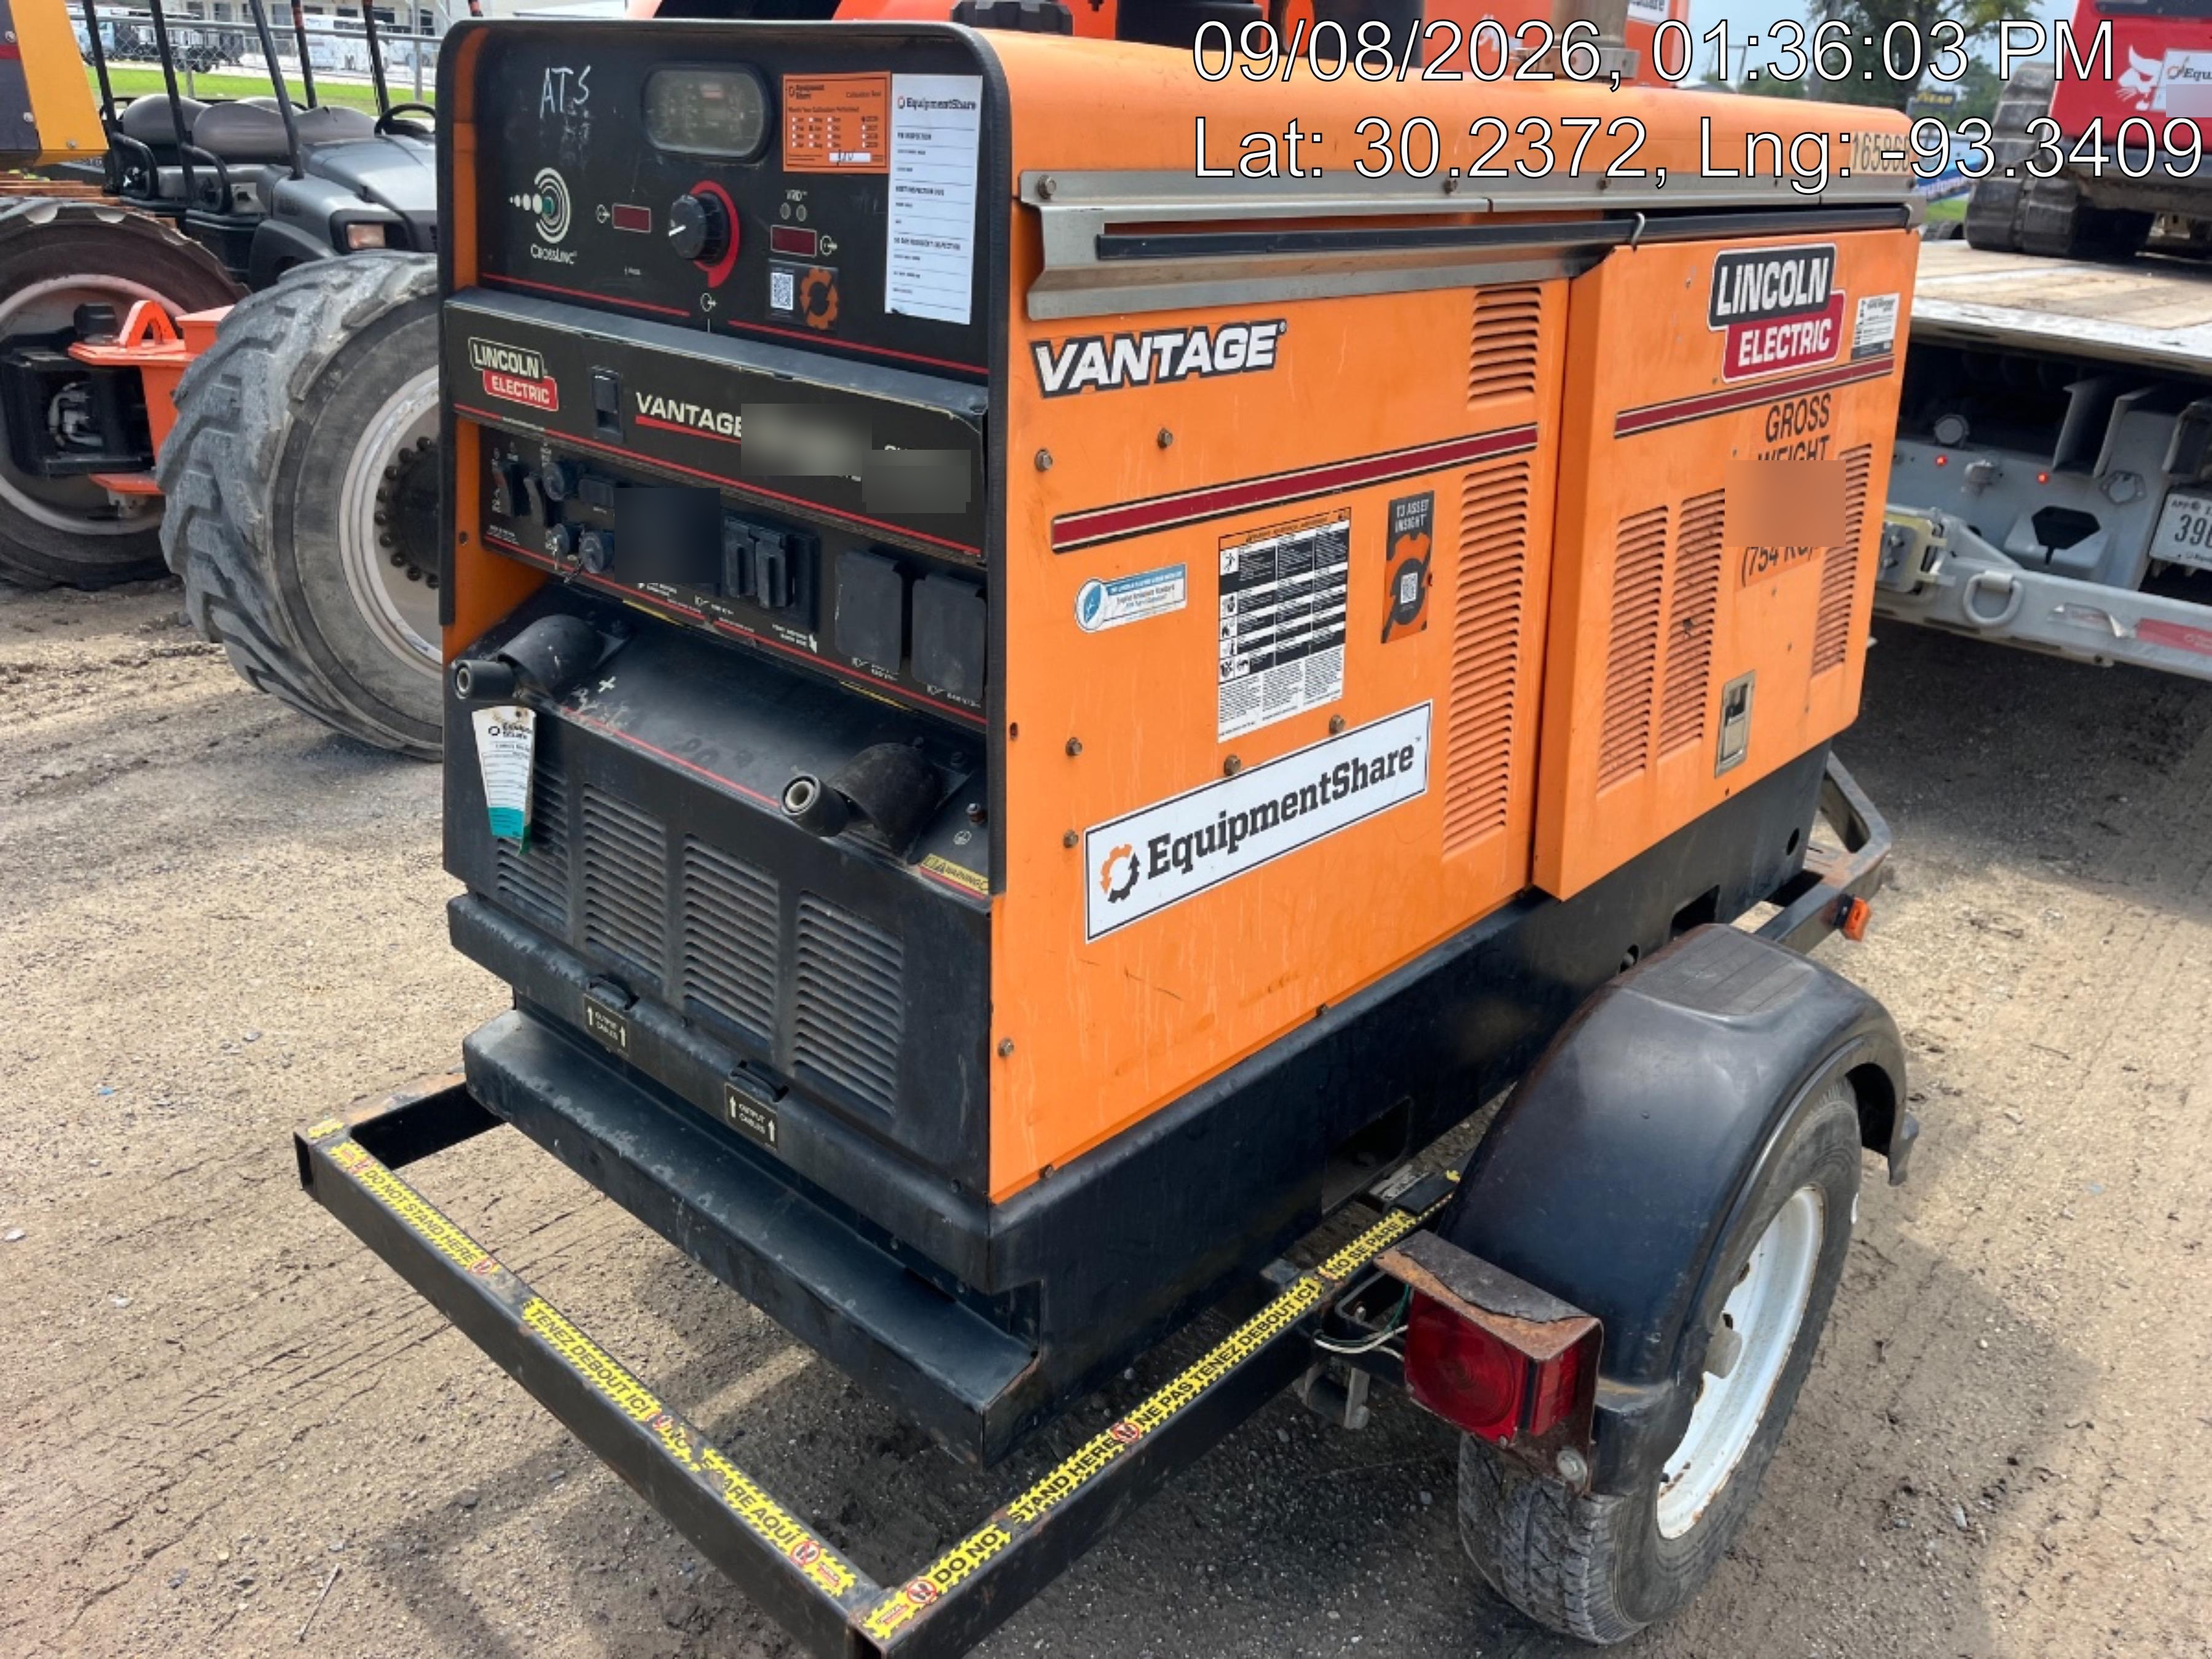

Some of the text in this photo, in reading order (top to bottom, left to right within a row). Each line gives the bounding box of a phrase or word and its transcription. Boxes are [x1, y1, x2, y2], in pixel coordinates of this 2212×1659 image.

[539, 65, 591, 119] ATS
[1716, 257, 1829, 316] LINCOLN
[474, 343, 539, 378] LINCOLN
[1033, 321, 1283, 395] VANTAGE
[1738, 318, 1832, 367] ELECTRIC
[492, 376, 550, 404] ELECTRIC
[1765, 392, 1831, 443] GROSS
[1394, 513, 1427, 534] INSIGHT
[1406, 498, 1430, 517] ASSET
[1147, 743, 1414, 880] EquipmentShare
[365, 1169, 479, 1265] DO NOT STAND HERE
[530, 1308, 652, 1414] TENEZ DEBOUT ICI
[1139, 1282, 1317, 1426] NE PAS TENEZ DEBOUT ICI
[933, 1556, 967, 1583] DO
[1010, 1475, 1070, 1523] STAND
[1068, 1437, 1120, 1477] HERE
